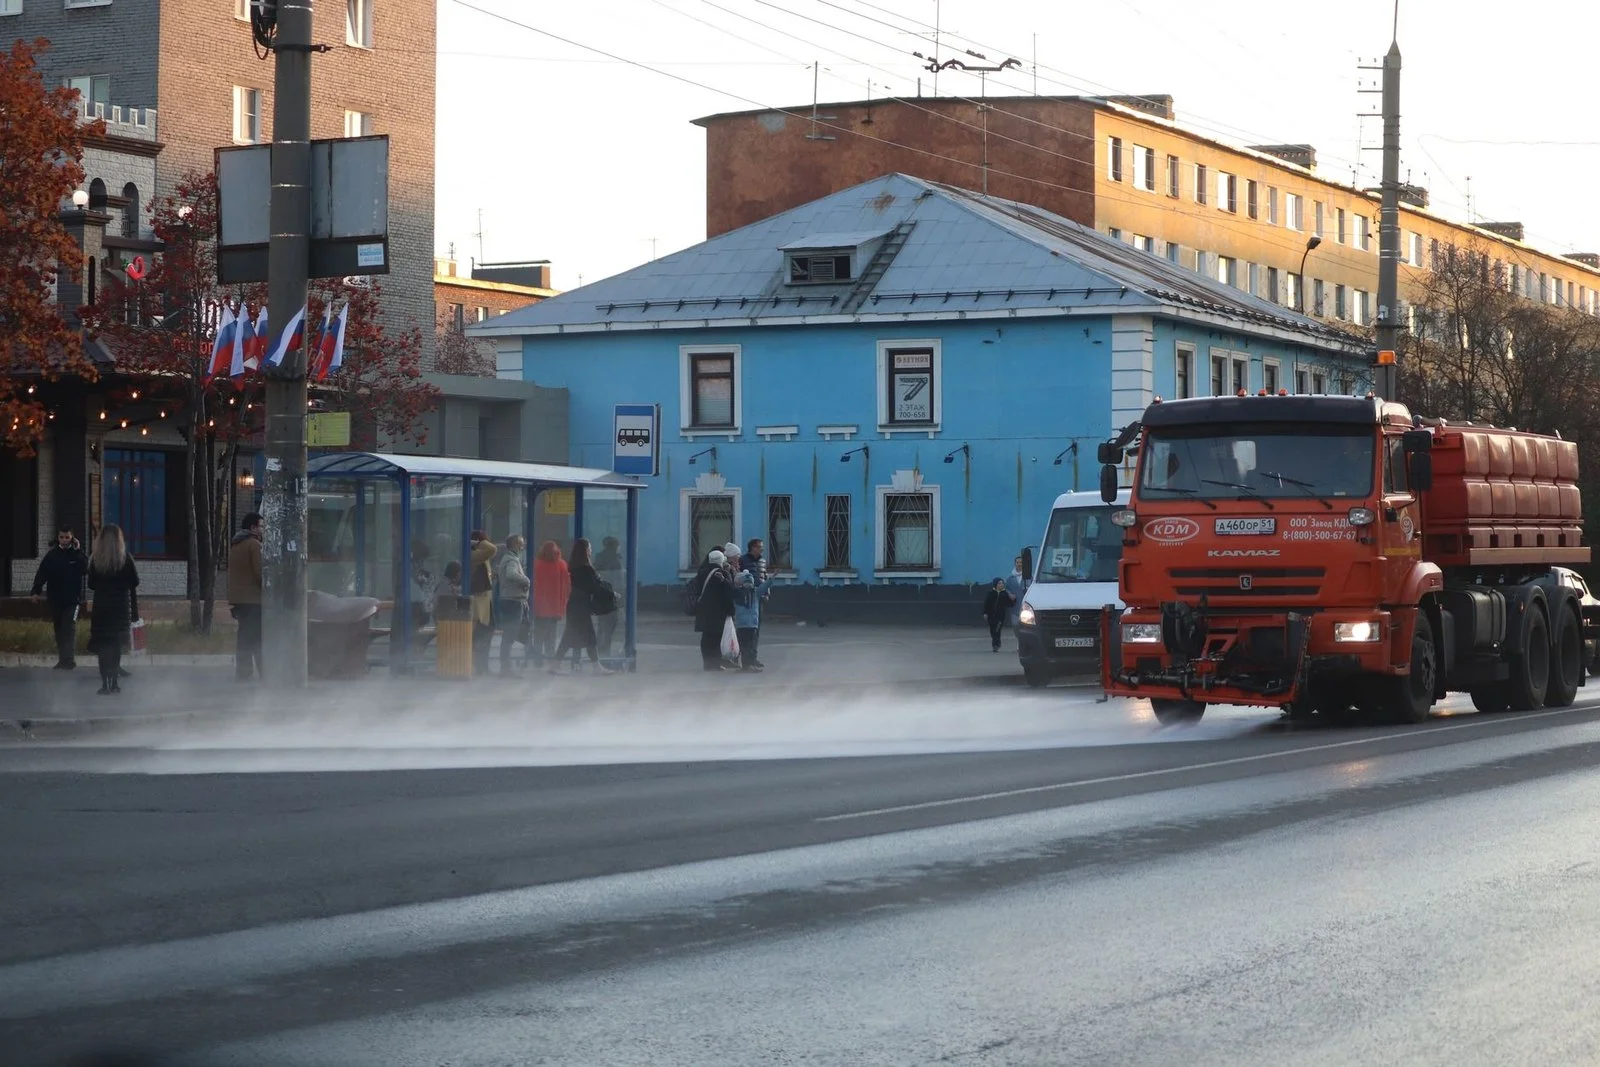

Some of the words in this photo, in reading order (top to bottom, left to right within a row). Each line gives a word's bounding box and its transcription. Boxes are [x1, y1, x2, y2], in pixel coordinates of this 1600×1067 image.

[1153, 524, 1189, 535] KDM
[1282, 530, 1356, 541] 8-(800)-500-67-67
[1207, 549, 1280, 557] KAMAZ
[1054, 553, 1071, 566] 57
